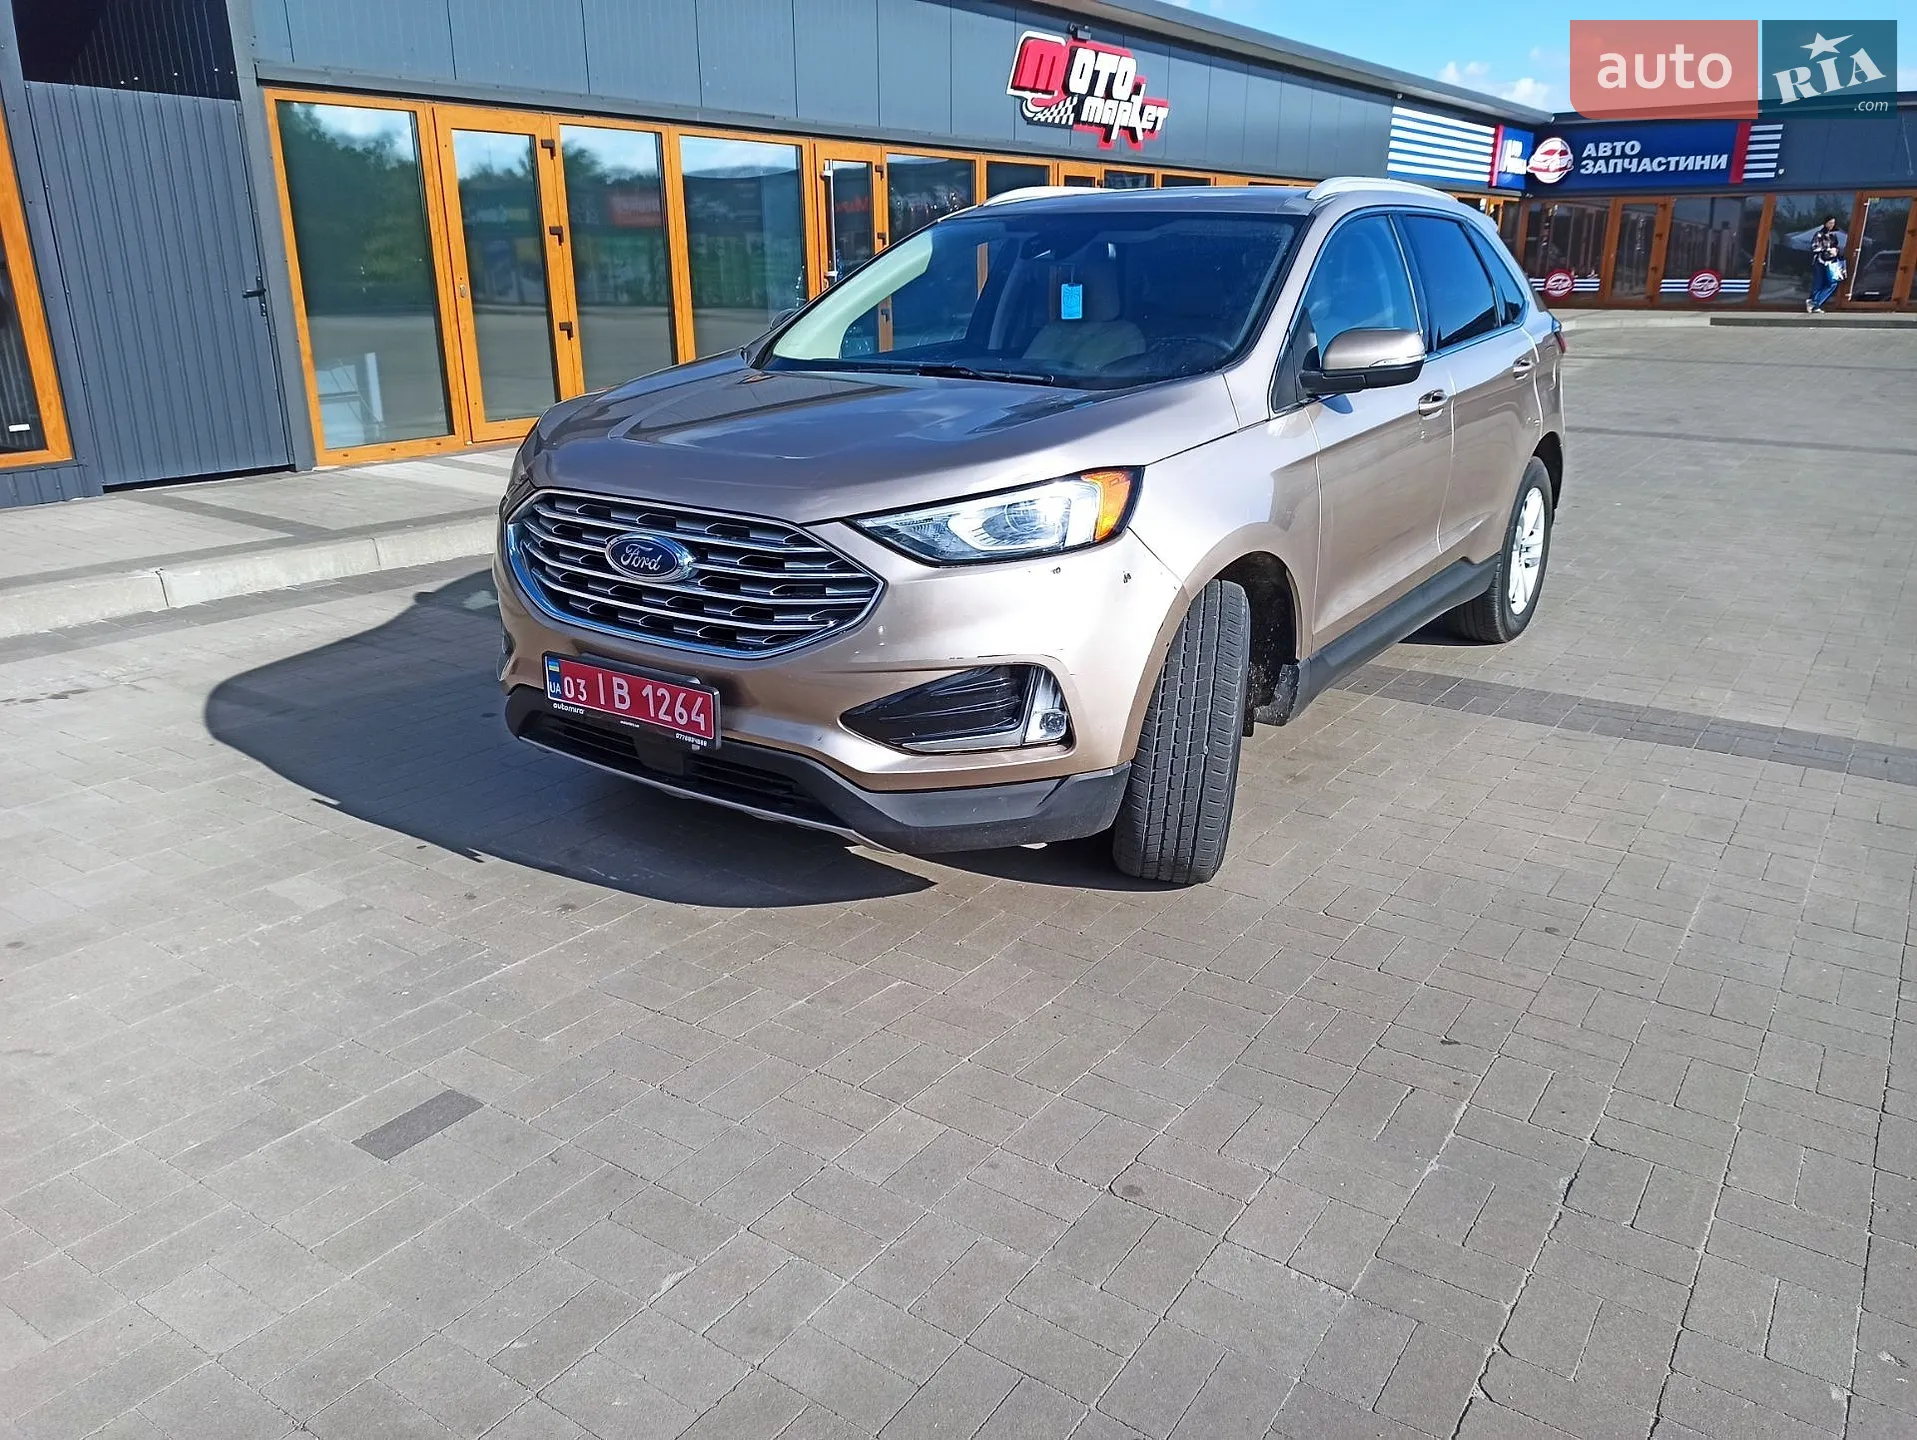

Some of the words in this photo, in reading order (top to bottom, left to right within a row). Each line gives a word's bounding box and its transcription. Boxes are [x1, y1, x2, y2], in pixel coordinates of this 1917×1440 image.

[1582, 141, 1642, 158] АВТО
[1580, 154, 1728, 175] ЗАПЧАСТИНИ
[620, 543, 662, 571] Ford
[549, 680, 562, 695] UA
[563, 676, 588, 702] 03
[597, 673, 631, 710] IB
[641, 684, 706, 731] 1264
